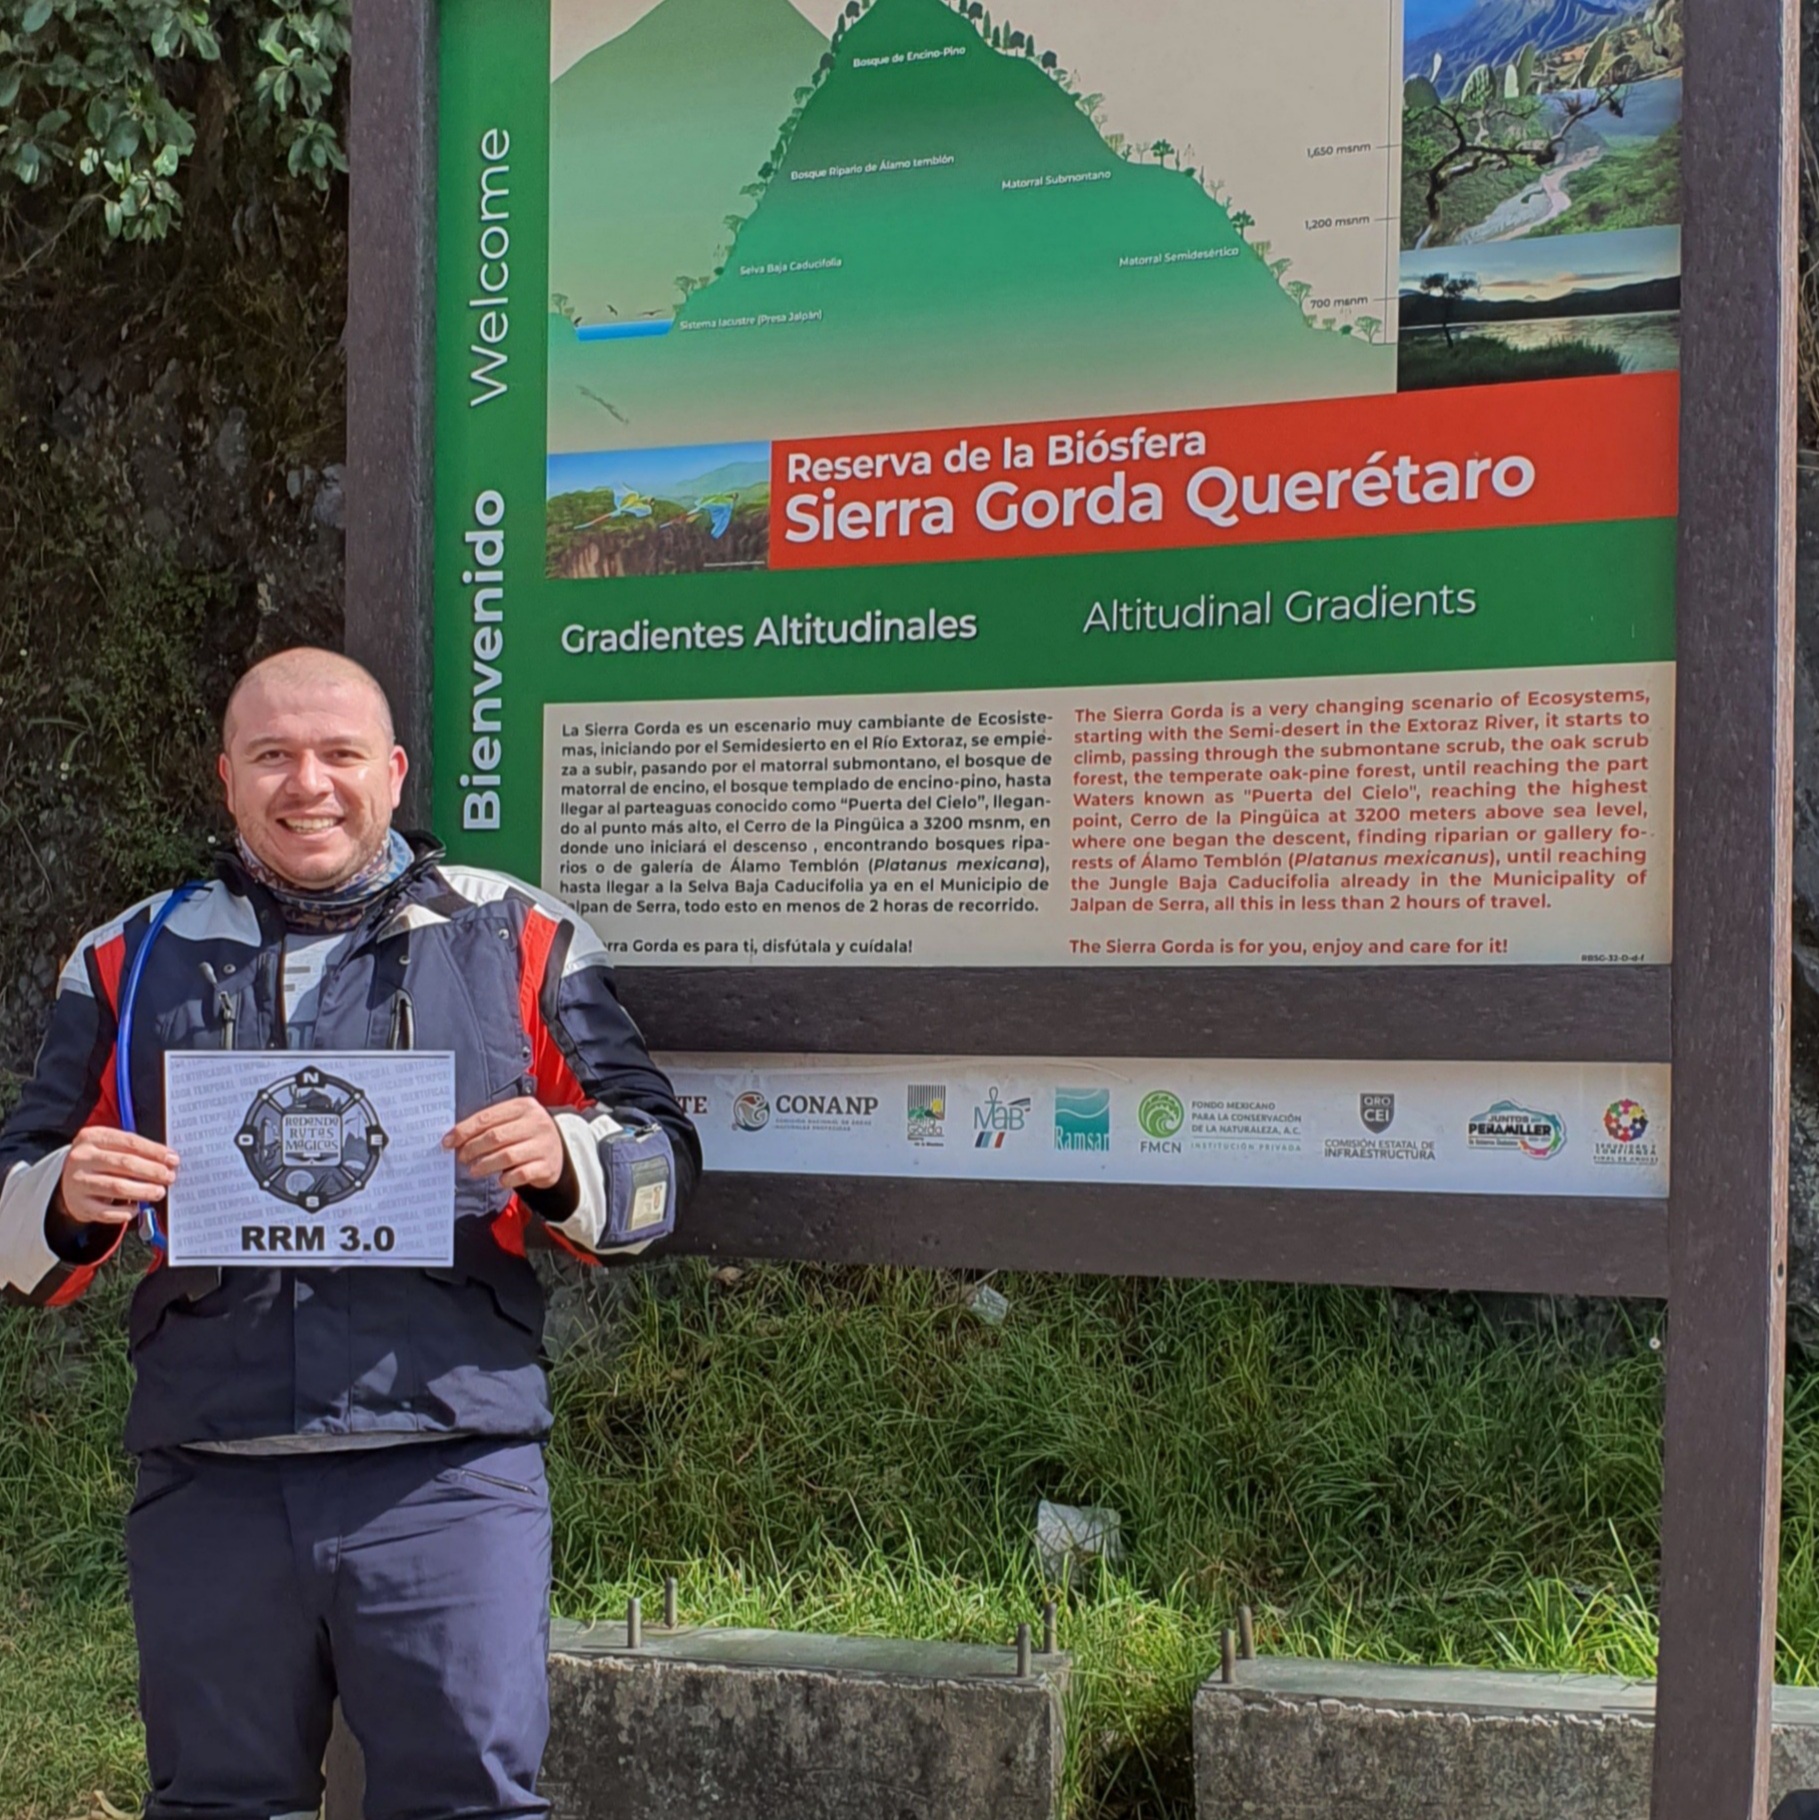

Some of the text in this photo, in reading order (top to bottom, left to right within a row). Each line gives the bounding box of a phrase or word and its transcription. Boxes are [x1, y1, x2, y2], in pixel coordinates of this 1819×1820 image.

[853, 45, 966, 68] Bosque de Encino-Pino
[1307, 143, 1371, 159] 1,650 msnm
[829, 164, 862, 177] Ripario
[865, 162, 877, 173] de
[1001, 170, 1111, 190] Matorral Submontano
[1305, 215, 1370, 231] 1,200 msnm
[470, 126, 510, 408] Welcome
[767, 262, 788, 274] Baja
[789, 258, 842, 271] Caducifolia
[1119, 253, 1162, 267] Matorral
[1310, 296, 1368, 309] 700 msnm
[787, 427, 1207, 483] Reserva de la Biósfera
[784, 451, 1537, 544] Sierra Gorda Querétaro
[1083, 583, 1477, 633] Altitudinal Gradients
[561, 608, 978, 655] Gradientes Altitudinales
[460, 489, 506, 830] Bienvenido
[1074, 690, 1651, 722] The Sierra Gorda is a very changing scenario of Ecosystems,
[562, 711, 1053, 737] La Sierra Gorda es un escenario muy cambiante de Ecosiste-
[560, 801, 603, 817] llegar
[607, 801, 620, 814] al
[624, 800, 711, 816] parteaguas
[715, 799, 787, 812] conocido
[791, 801, 836, 811] como
[906, 796, 931, 809] del
[993, 795, 1051, 811] llegan-
[559, 857, 1050, 875] rios o de galería de Álamo Temblón (Platanus mexicana),
[1071, 850, 1646, 869] rests of Álamo Temblón (Platanus mexicanus), until reaching
[604, 939, 913, 955] rra Gorda es para ti, disfútala y cuídala!
[1070, 940, 1508, 956] The Sierra Gorda is for you, enjoy and care for it!
[303, 1072, 319, 1084] N
[775, 1094, 879, 1115] CONANP
[1192, 1101, 1276, 1111] FONDO MEXICANO
[1364, 1096, 1391, 1106] QRO
[1192, 1113, 1302, 1123] PARA LA CONSERVACIÓN
[1364, 1108, 1389, 1122] CEI
[1054, 1125, 1110, 1151] Ramsar
[1192, 1124, 1302, 1136] DE LA NATURALEZA, A.C.
[1140, 1140, 1182, 1154] FMCN
[1324, 1138, 1435, 1150] COMISIÓN ESTATAL DE
[1324, 1148, 1436, 1160] INFRAESTRUCTURA
[241, 1225, 395, 1252] RRM 3.0
